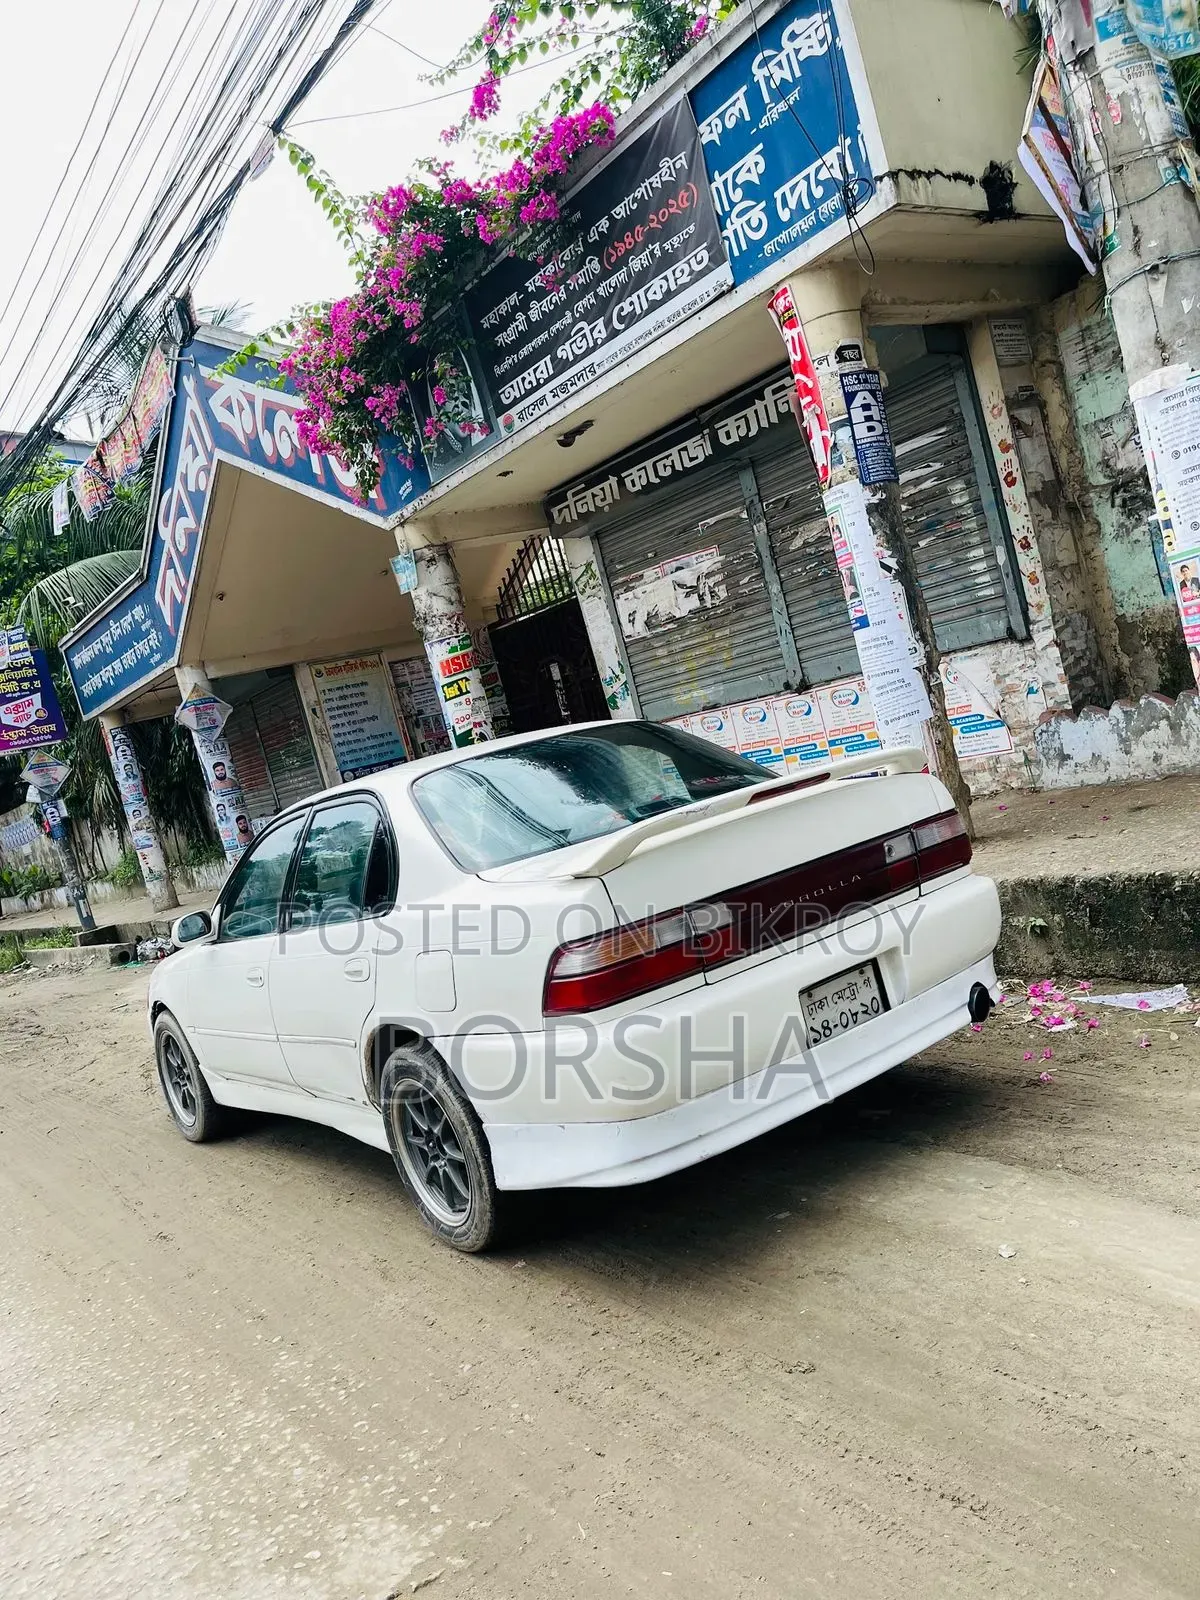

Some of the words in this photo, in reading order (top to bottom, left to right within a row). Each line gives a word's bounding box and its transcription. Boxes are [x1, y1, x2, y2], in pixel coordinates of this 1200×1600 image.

[698, 85, 751, 146] ফল
[480, 291, 524, 329] মহাকাল-
[587, 215, 610, 244] এক
[611, 151, 688, 220] আপোষহীন
[494, 312, 528, 348] সংগ্রামী
[528, 285, 567, 322] জীবনের
[603, 182, 698, 270] (১৯৪৫-২০২৫)
[574, 291, 597, 318] বেগম
[596, 265, 629, 298] খালেদা
[628, 241, 662, 277] জিয়া'র
[498, 354, 554, 405] আমরা
[557, 316, 607, 362] গভীর
[612, 242, 710, 330] শোকাহত
[843, 375, 858, 386] HSC
[845, 384, 871, 393] FOUNDATION
[516, 394, 549, 423] রাসেল
[551, 475, 620, 525] দনিয়া
[439, 652, 473, 677] HSC
[769, 875, 861, 913] COROLLA
[806, 996, 830, 1020] ঢাকা
[810, 997, 880, 1043] ১৪-০৮২০
